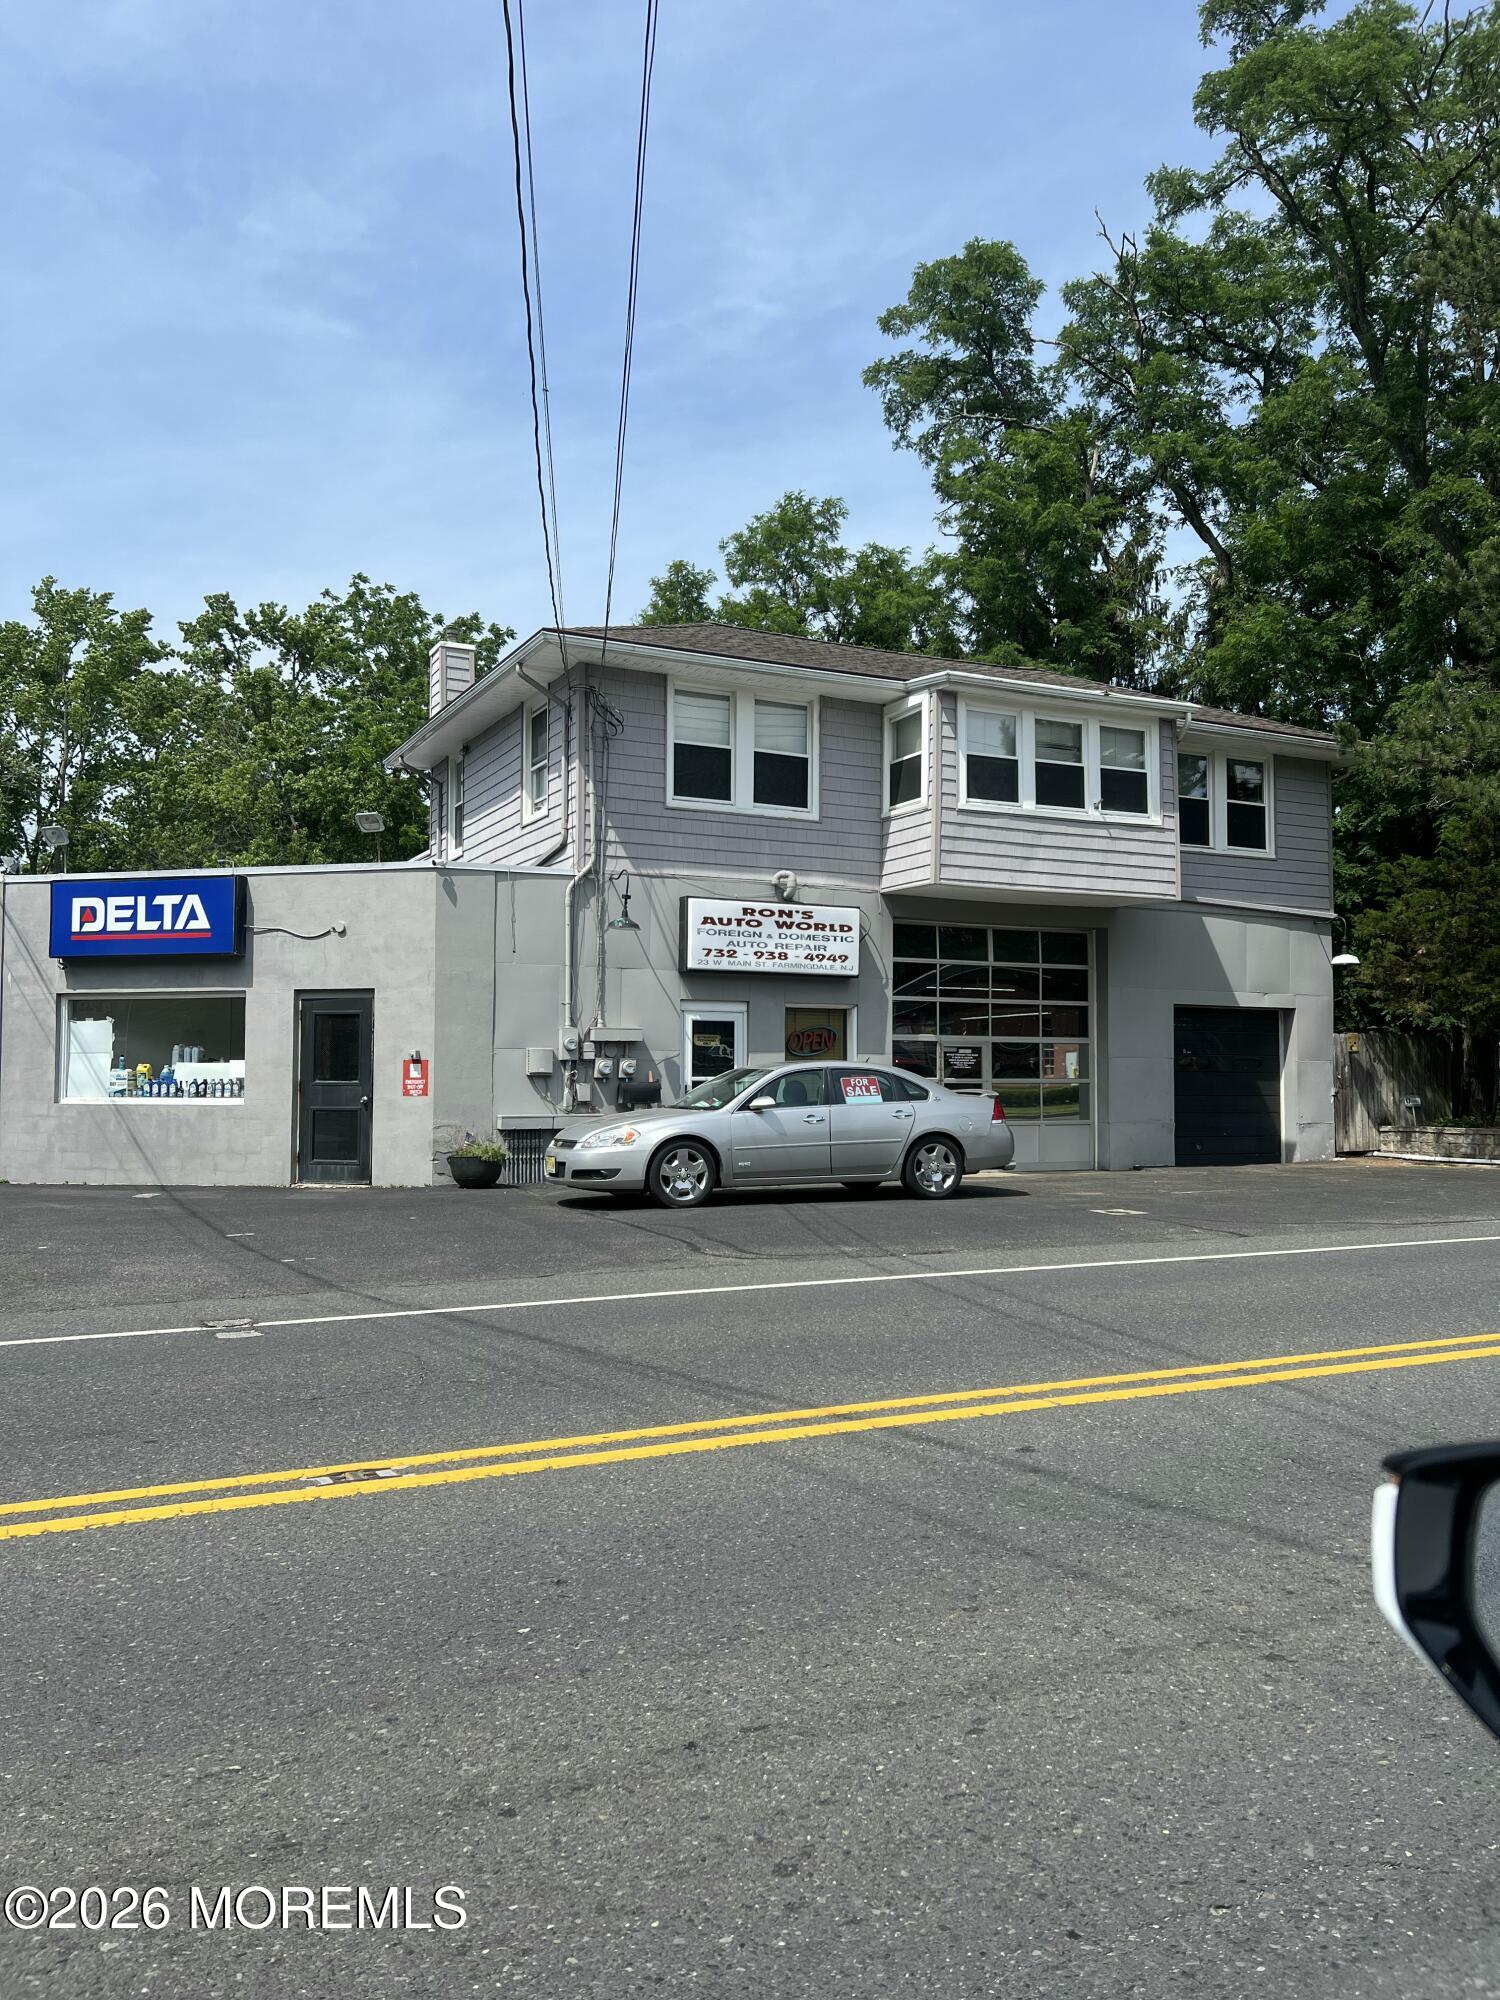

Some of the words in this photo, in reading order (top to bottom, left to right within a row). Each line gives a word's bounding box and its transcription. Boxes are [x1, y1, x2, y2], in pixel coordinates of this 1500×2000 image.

[71, 894, 211, 932] DELTA
[742, 907, 814, 920] RON'S
[700, 916, 763, 928] AUTO
[774, 920, 853, 933] WORLD
[697, 928, 762, 938] FOREIGN
[778, 933, 855, 943] DOMESTIC
[726, 940, 768, 949] AUTO
[774, 943, 828, 952] REPAIR
[788, 1031, 834, 1051] OPEN
[850, 1078, 869, 1087] FOR
[846, 1086, 878, 1097] SALE
